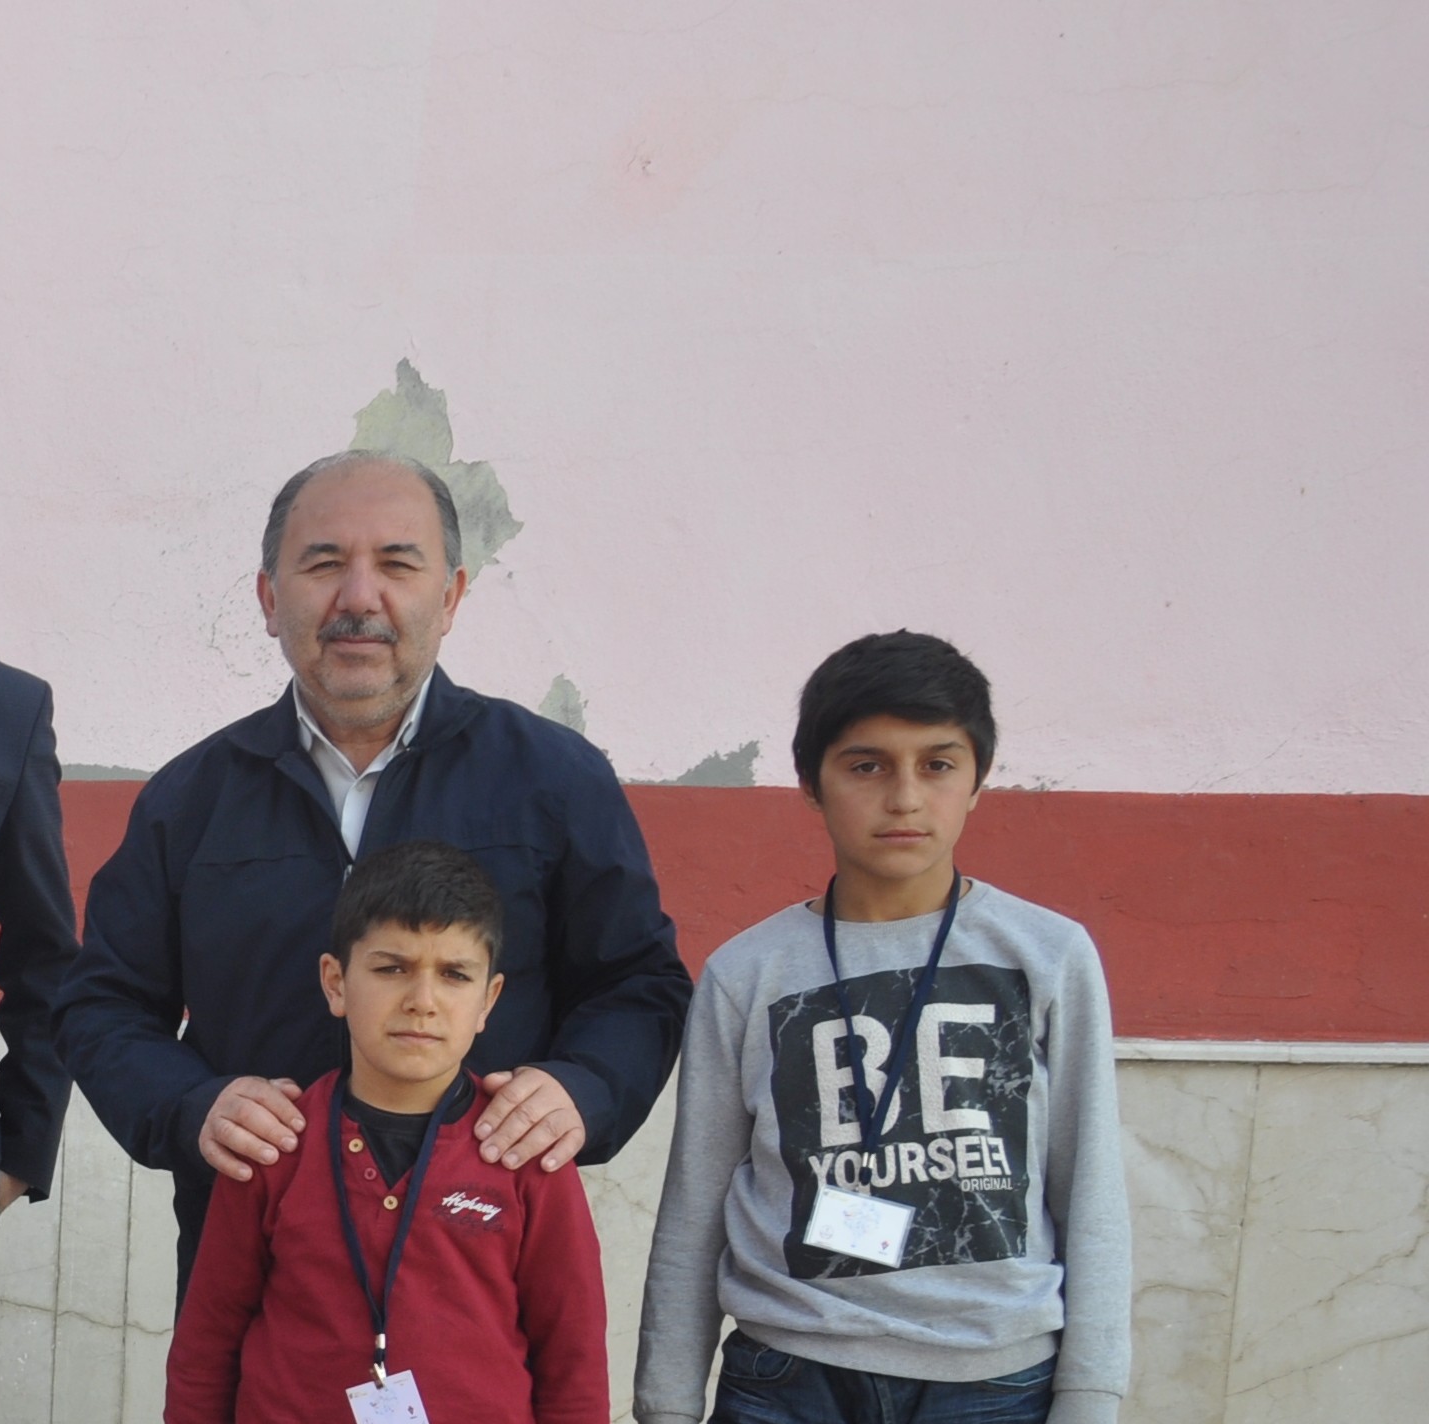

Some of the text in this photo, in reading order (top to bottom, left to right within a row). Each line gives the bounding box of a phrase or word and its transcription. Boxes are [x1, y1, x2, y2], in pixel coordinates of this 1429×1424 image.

[812, 1002, 996, 1148] BE
[960, 1177, 1014, 1192] ORIGINAL
[441, 1191, 502, 1221] Highway
